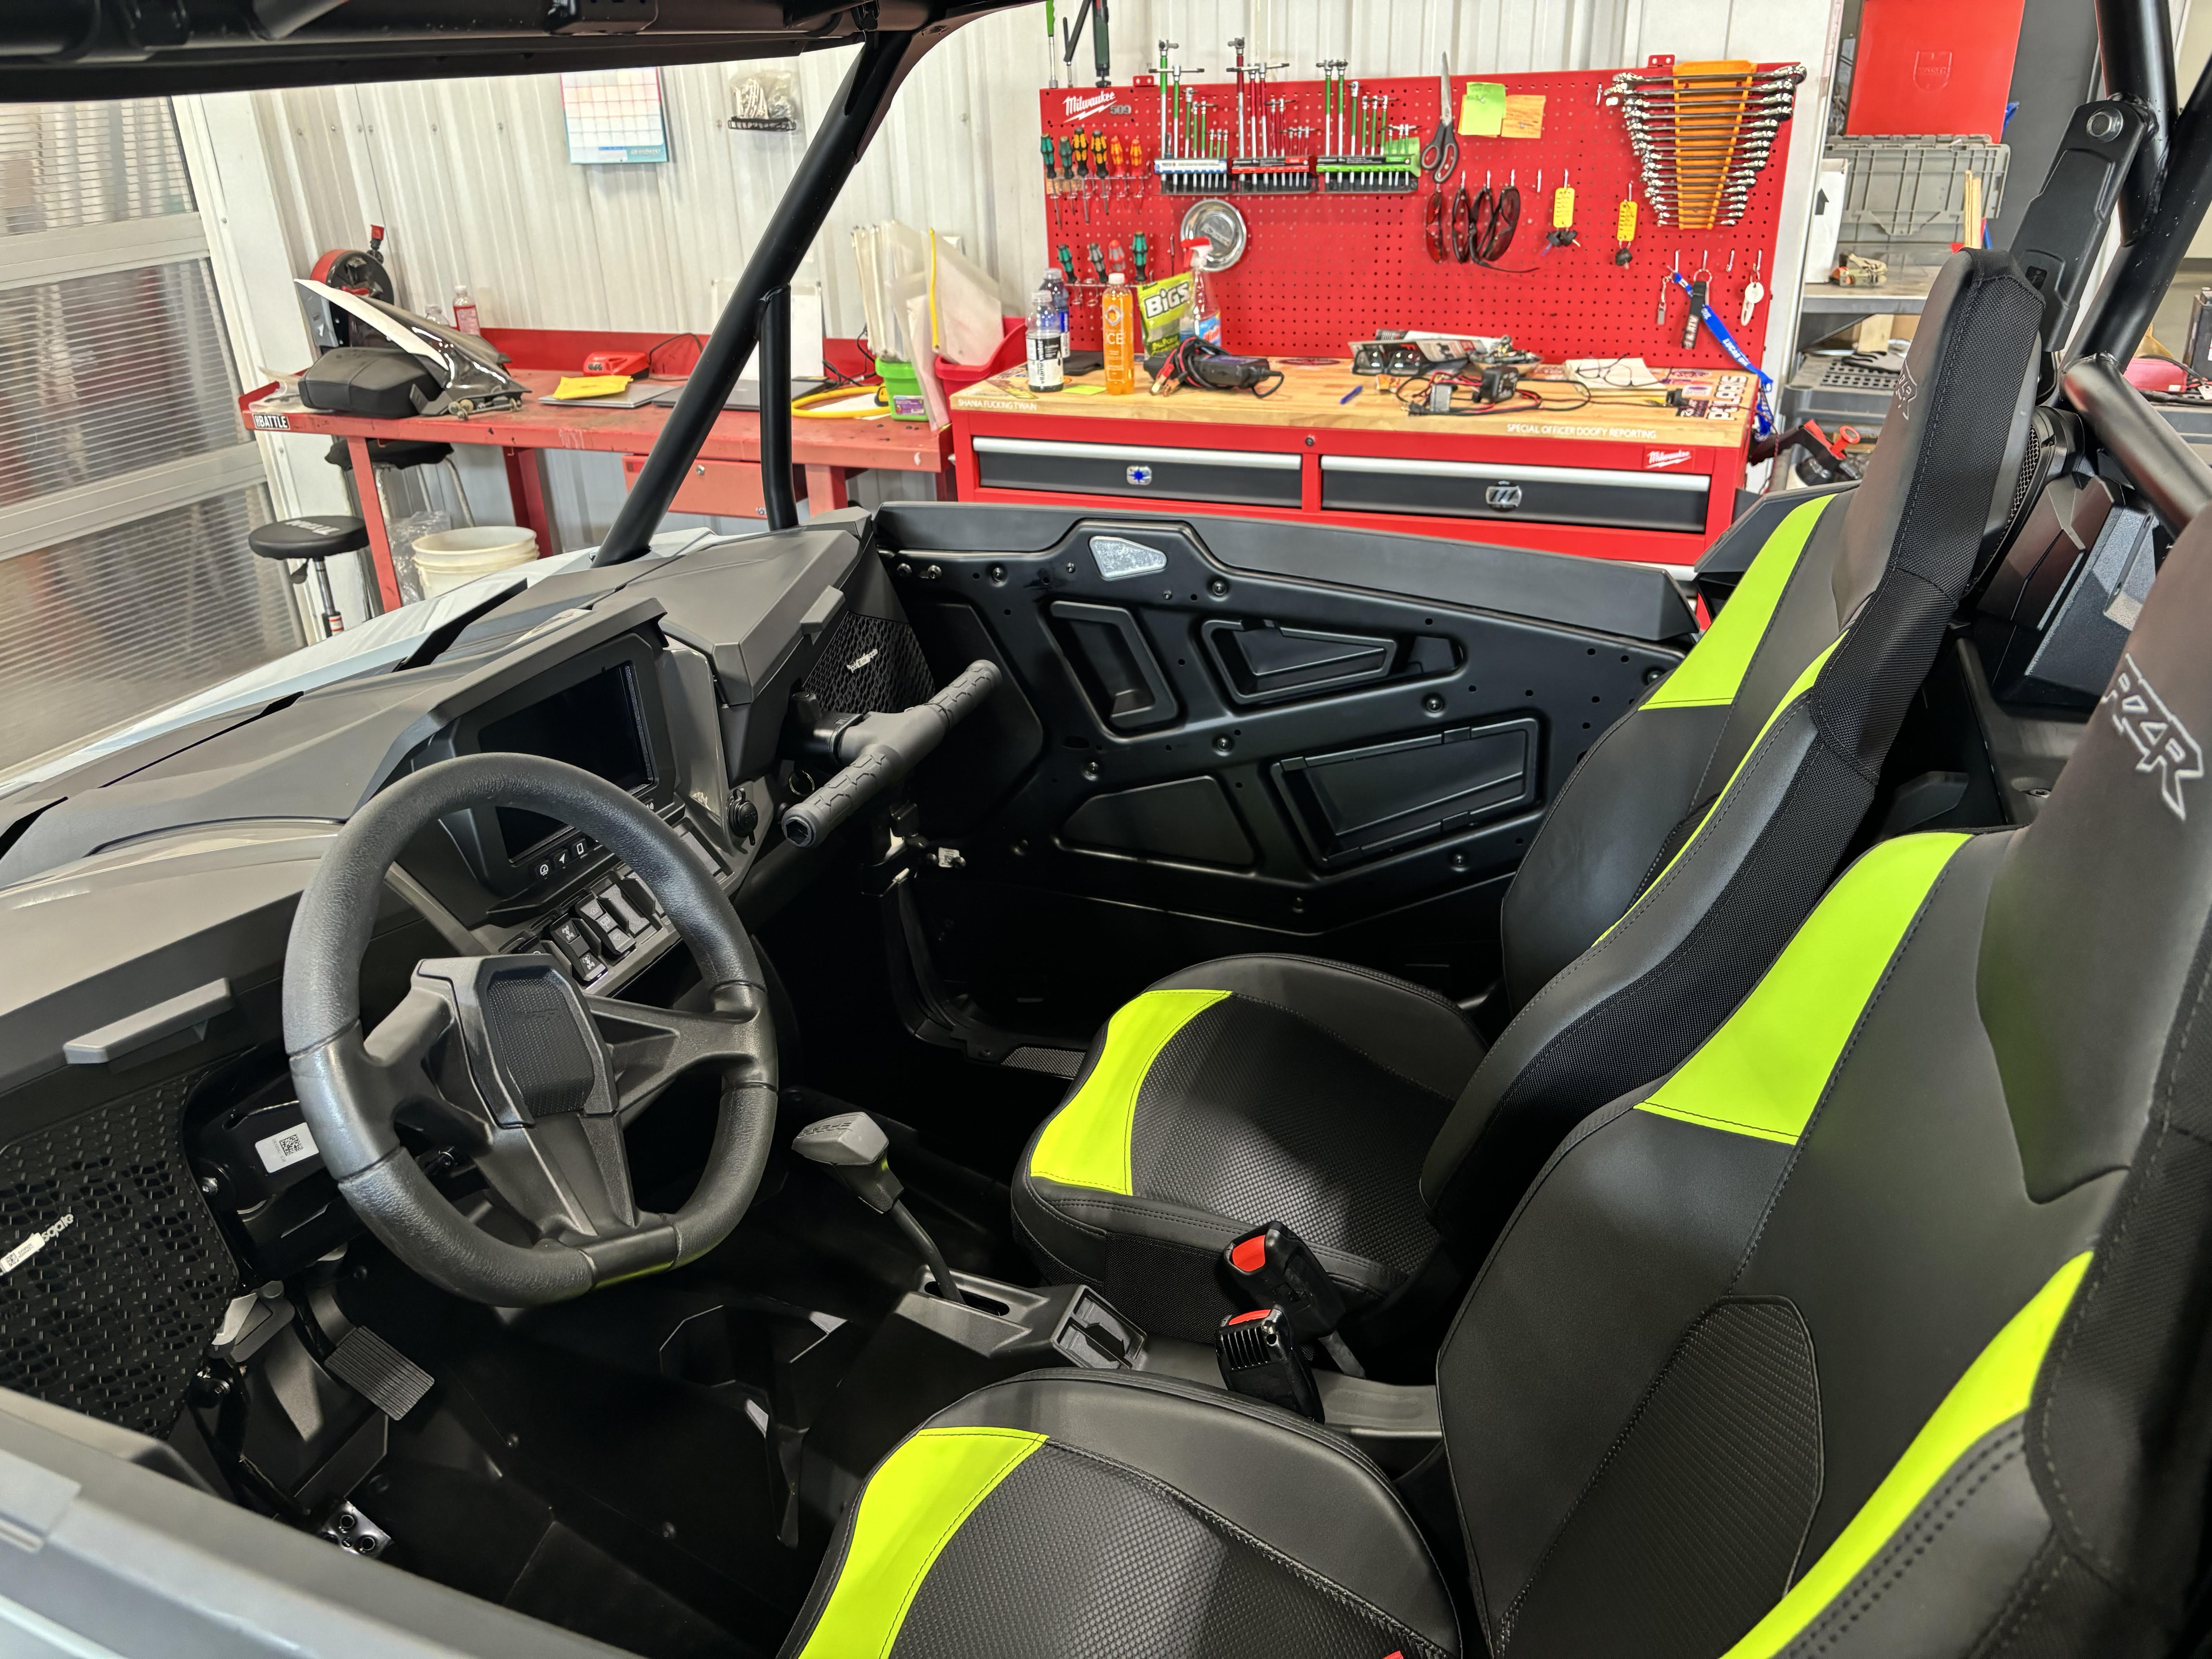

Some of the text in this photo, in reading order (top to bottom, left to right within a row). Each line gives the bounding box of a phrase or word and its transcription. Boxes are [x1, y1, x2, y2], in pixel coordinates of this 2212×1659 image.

[1062, 91, 1116, 116] Milwaukee
[958, 398, 982, 407] SHANIA
[1507, 423, 1657, 439] SPECIAL OFFICER DOOFY REPORTING
